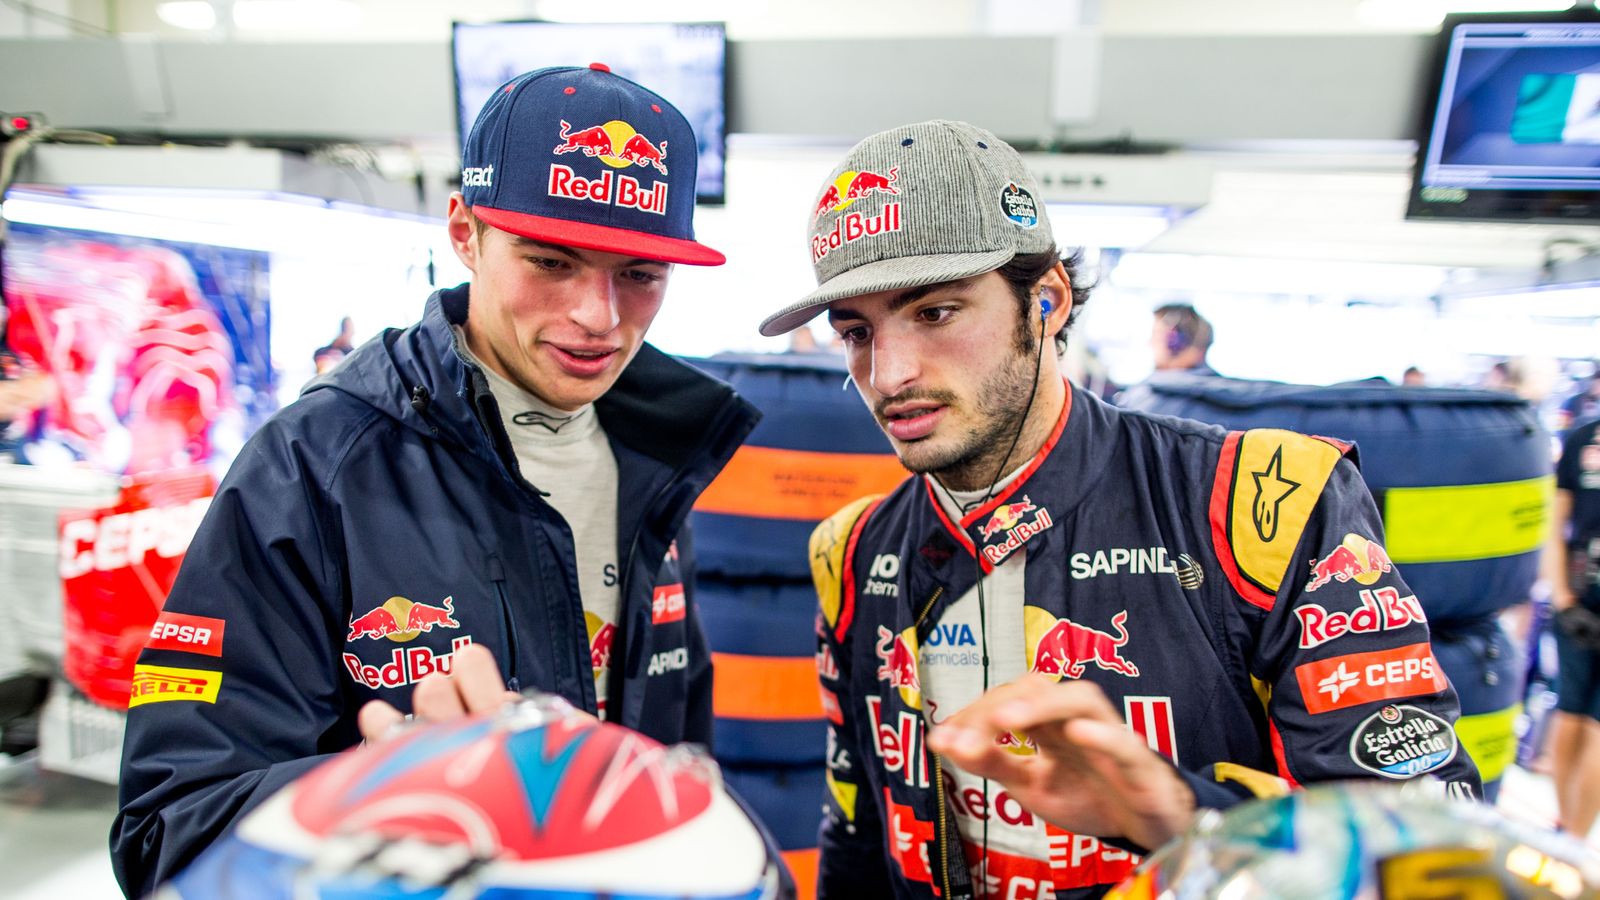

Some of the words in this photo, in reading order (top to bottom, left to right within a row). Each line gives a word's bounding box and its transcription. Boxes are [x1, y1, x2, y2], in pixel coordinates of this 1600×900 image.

[548, 163, 613, 205] Red
[615, 174, 669, 215] Bull
[811, 218, 840, 263] Red
[845, 203, 900, 243] Bull
[983, 528, 1022, 564] Red
[1013, 507, 1053, 543] Bull
[1071, 547, 1177, 579] SAPIND
[150, 622, 211, 645] EPSA
[1293, 589, 1380, 649] Red
[1374, 586, 1428, 630] Bu
[926, 623, 977, 646] OVA
[342, 647, 407, 689] Red
[1365, 657, 1436, 687] CEPS
[131, 682, 204, 698] RELLI
[1363, 718, 1439, 753] Estrella
[1376, 735, 1448, 765] Galicia
